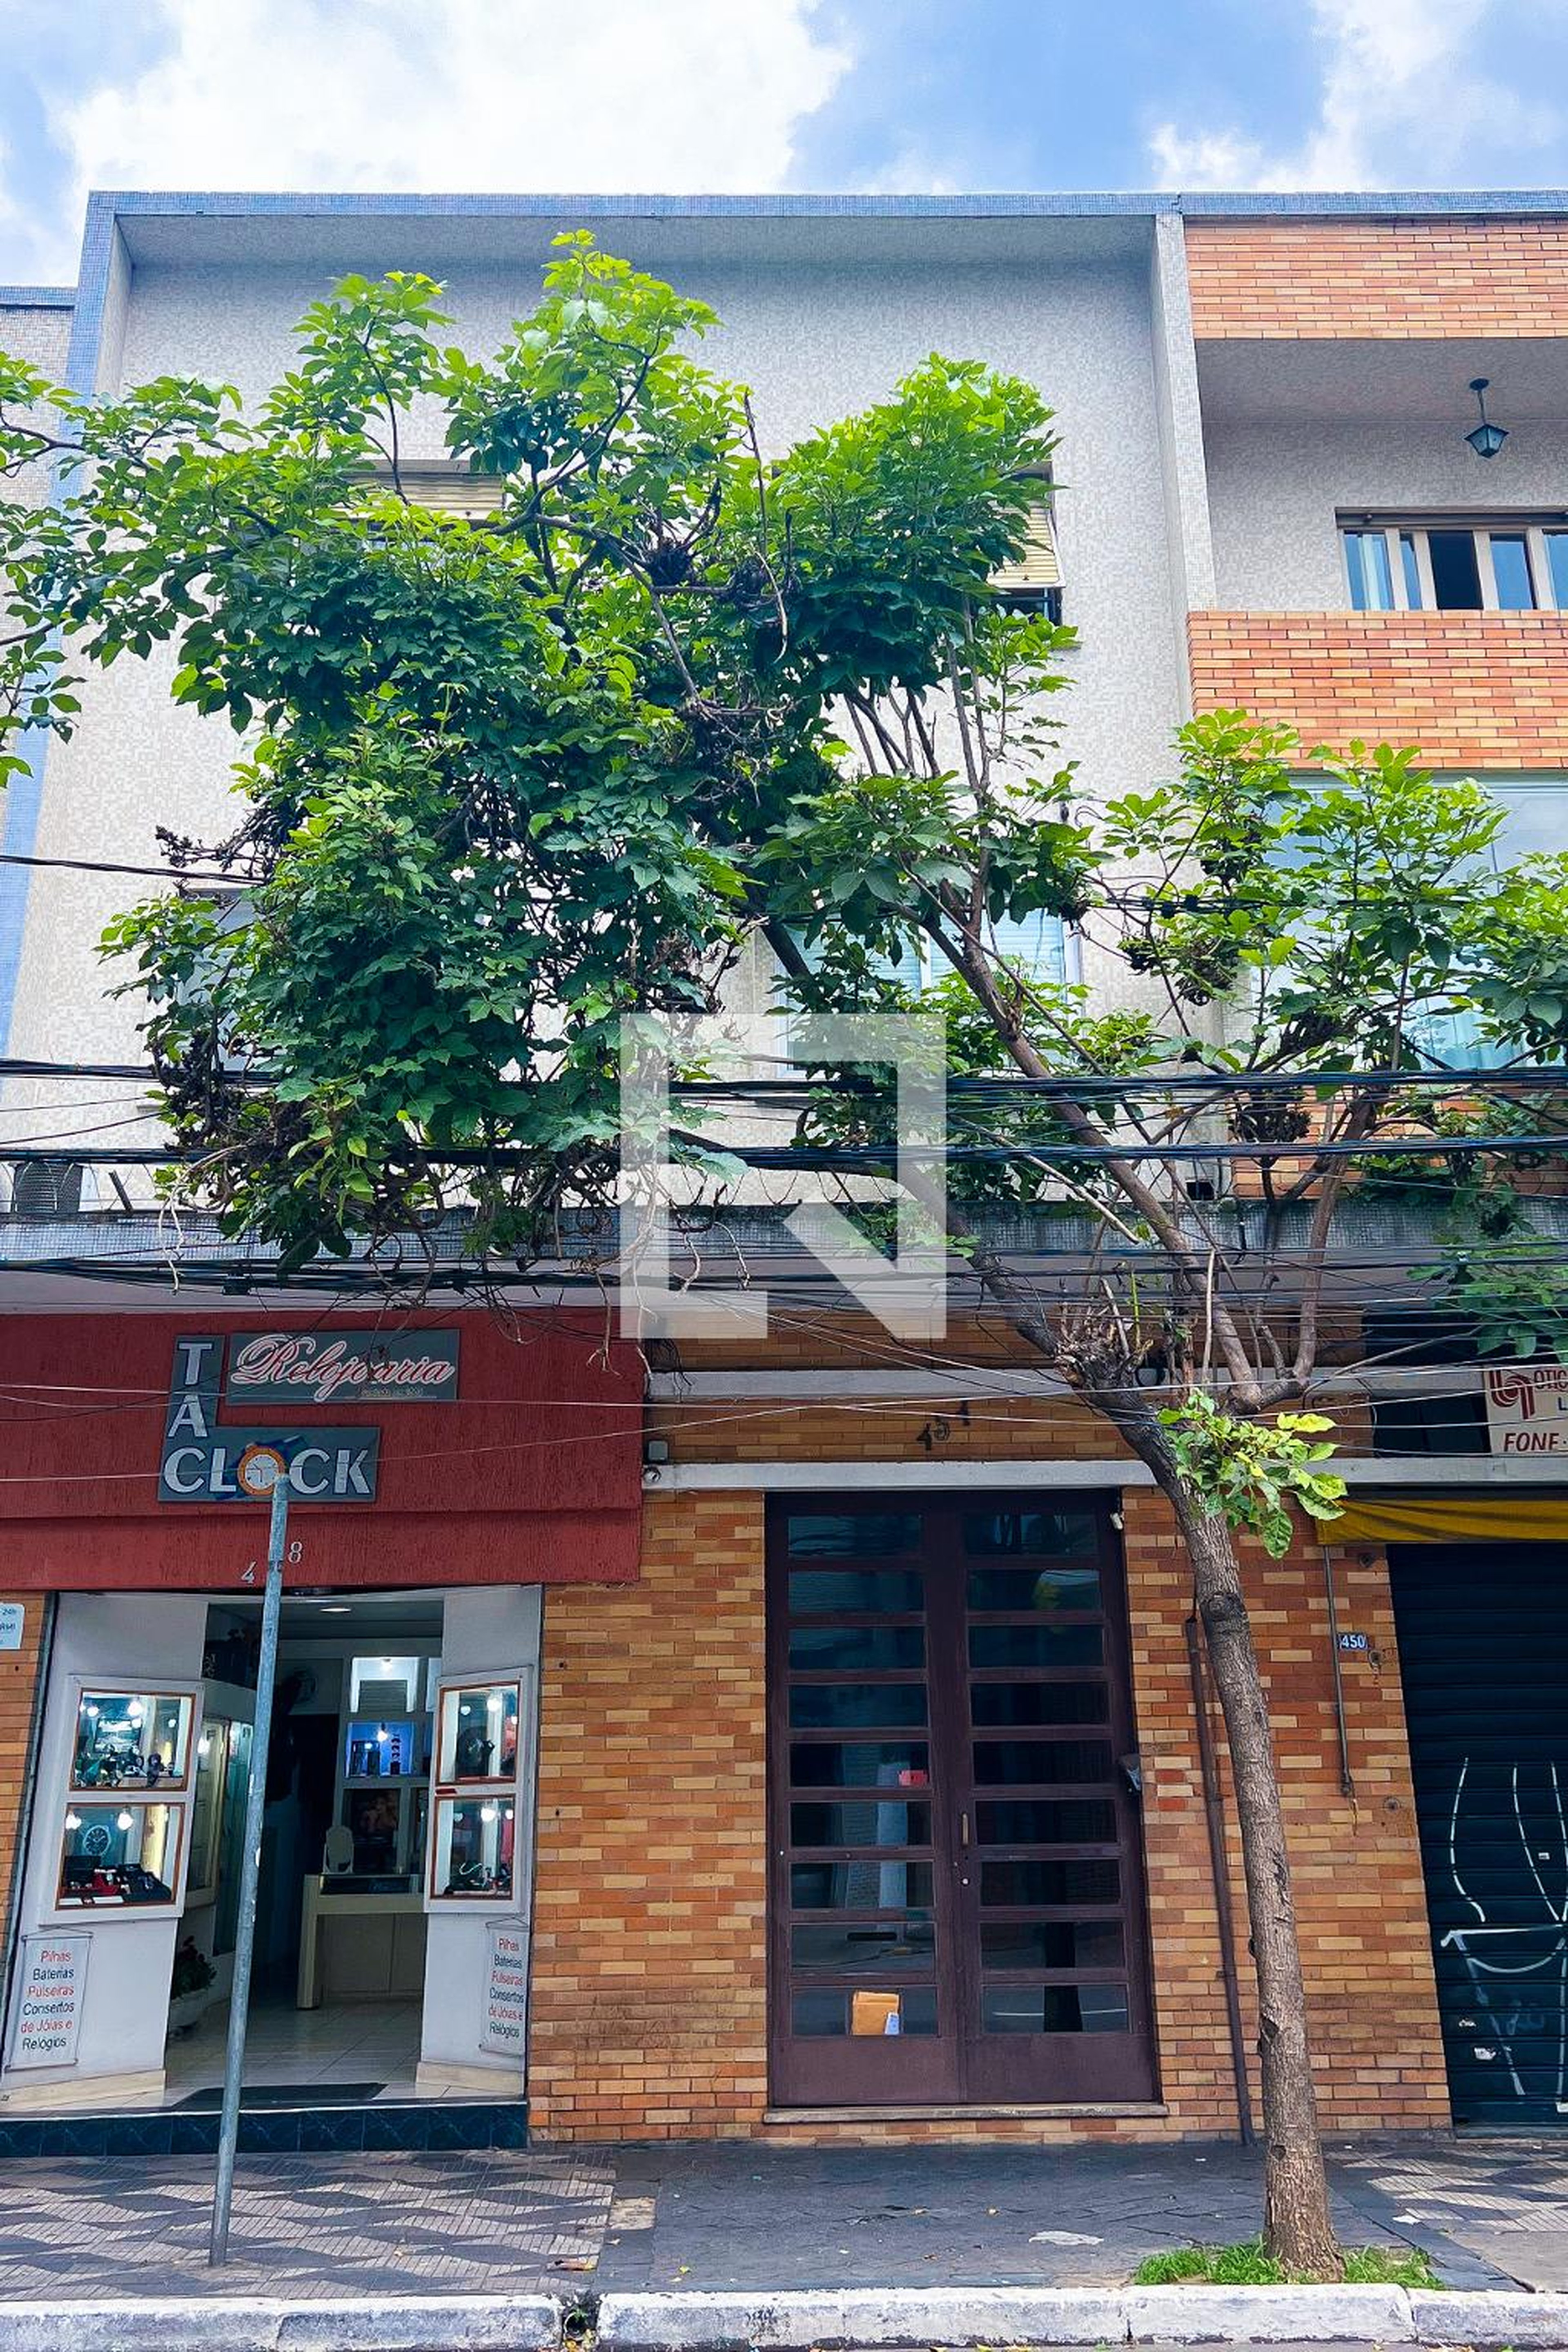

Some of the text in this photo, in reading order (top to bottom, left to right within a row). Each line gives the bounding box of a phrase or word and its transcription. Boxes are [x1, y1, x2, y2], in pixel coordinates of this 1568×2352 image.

[164, 1446, 370, 1496] CLOCK
[1341, 1635, 1365, 1648] 450
[33, 1967, 74, 1980] Baterias
[23, 2002, 74, 2016] Consertos
[21, 2022, 34, 2034] de
